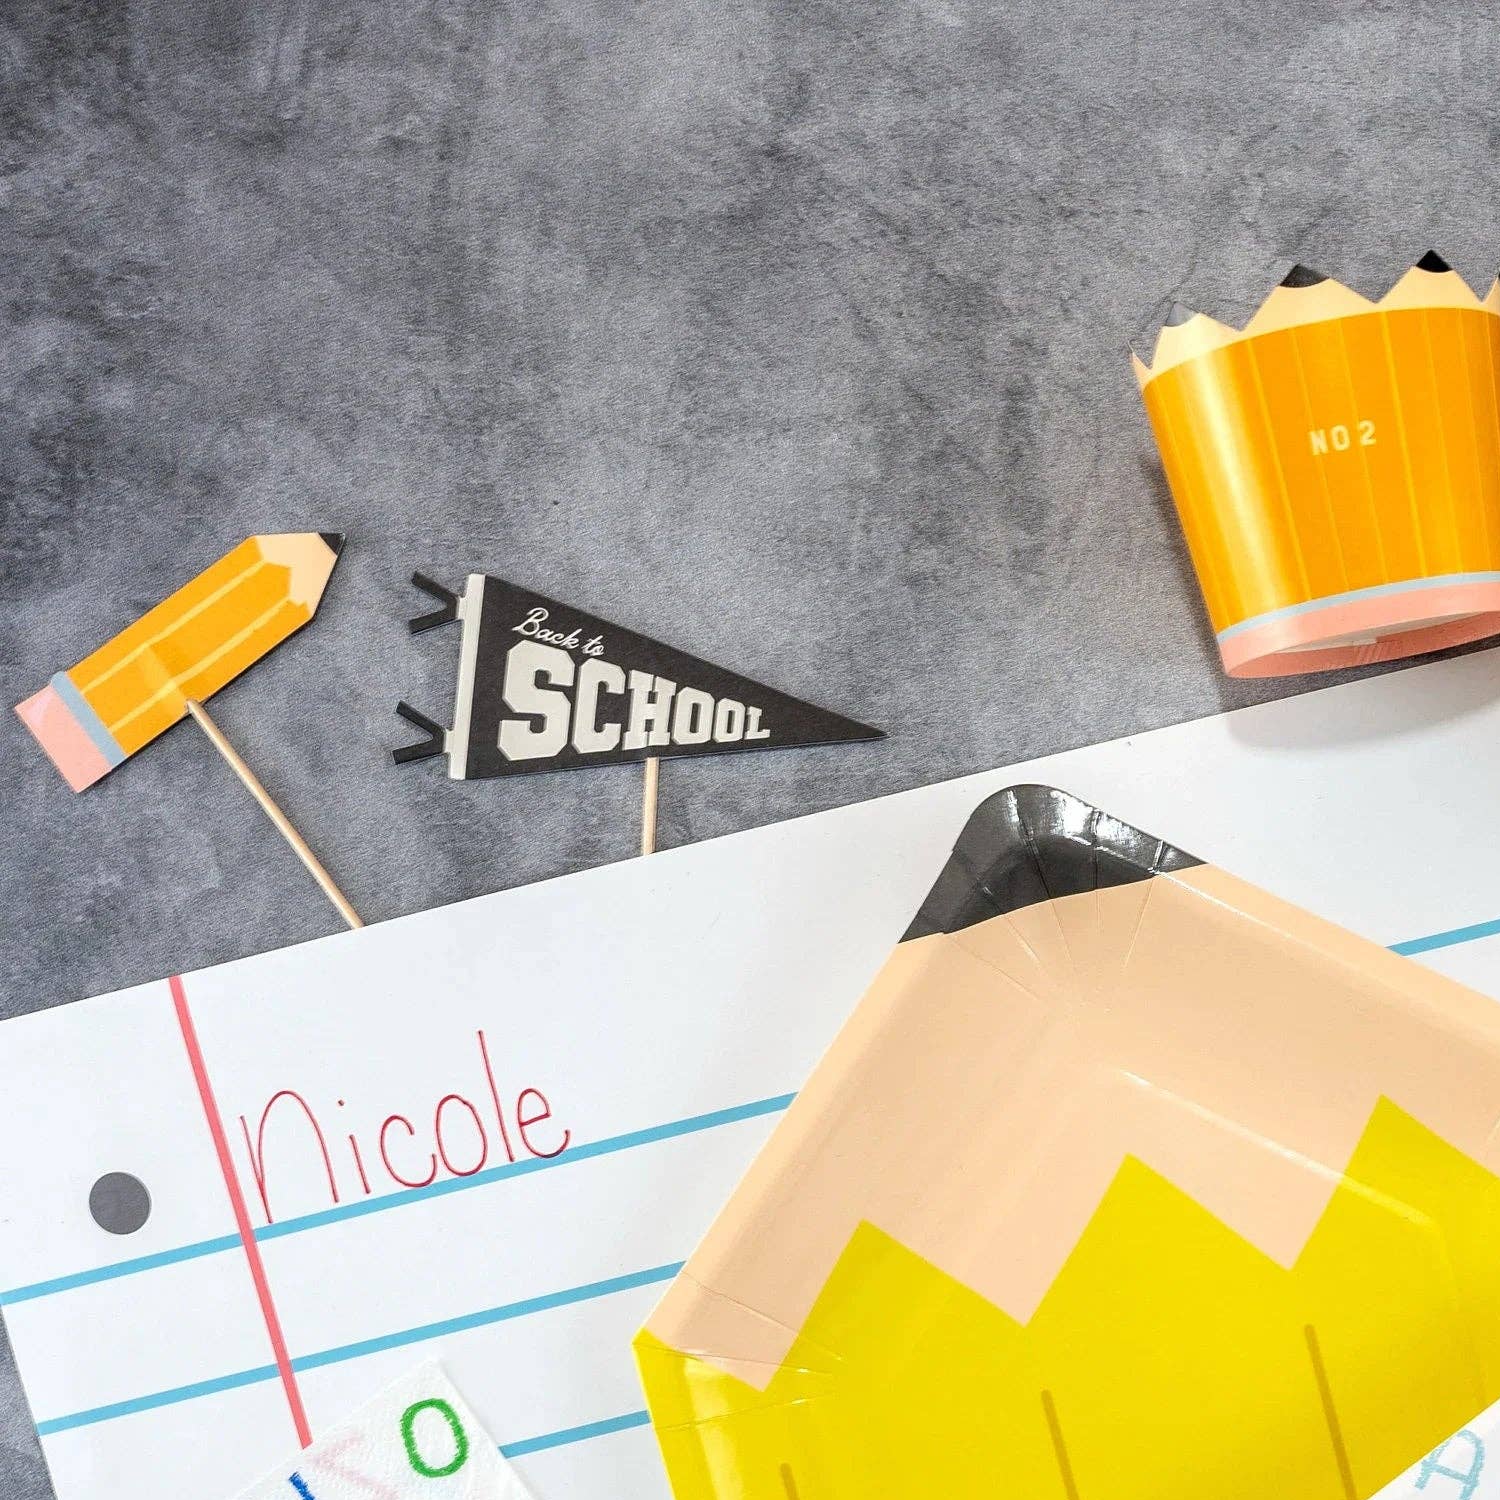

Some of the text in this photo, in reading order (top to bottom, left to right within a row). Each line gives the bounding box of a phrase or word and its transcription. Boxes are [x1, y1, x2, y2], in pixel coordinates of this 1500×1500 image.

[512, 607, 605, 656] Back to
[497, 640, 771, 761] SCHOOL
